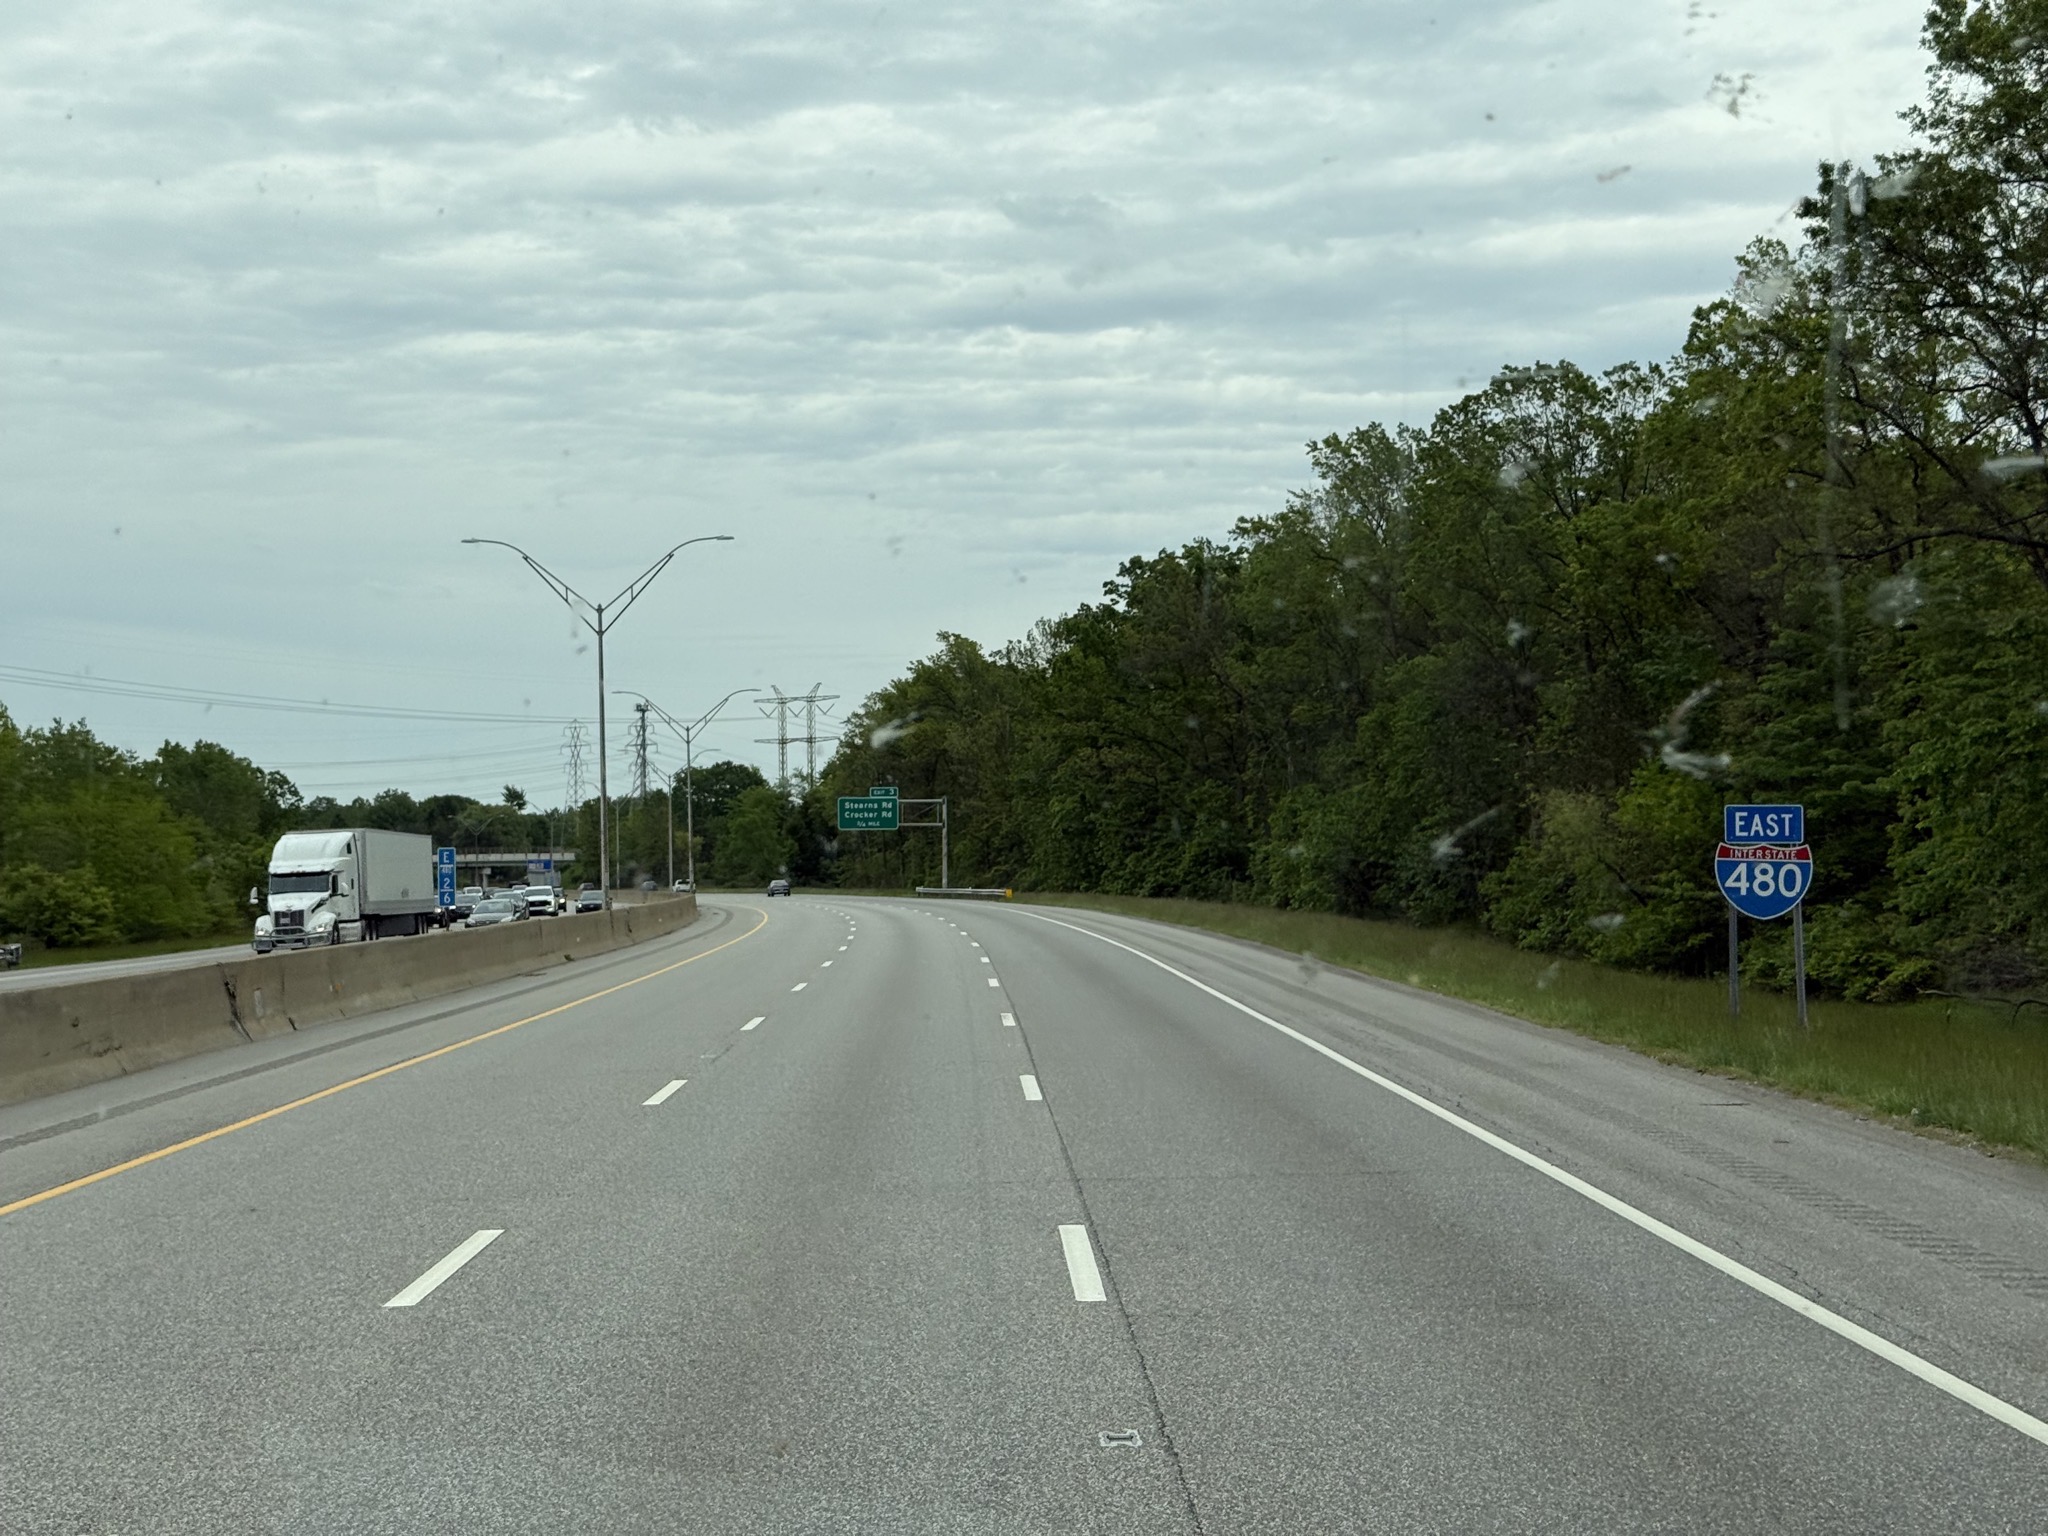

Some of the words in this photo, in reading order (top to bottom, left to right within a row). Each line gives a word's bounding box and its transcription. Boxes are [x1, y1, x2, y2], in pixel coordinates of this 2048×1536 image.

[844, 801, 878, 809] Stearns
[881, 801, 892, 809] Rd
[1735, 811, 1793, 837] EAST
[443, 851, 450, 863] E
[1730, 848, 1797, 860] INTERSTATE
[443, 877, 450, 889] 2
[1724, 862, 1802, 898] 480
[444, 892, 450, 904] 6
